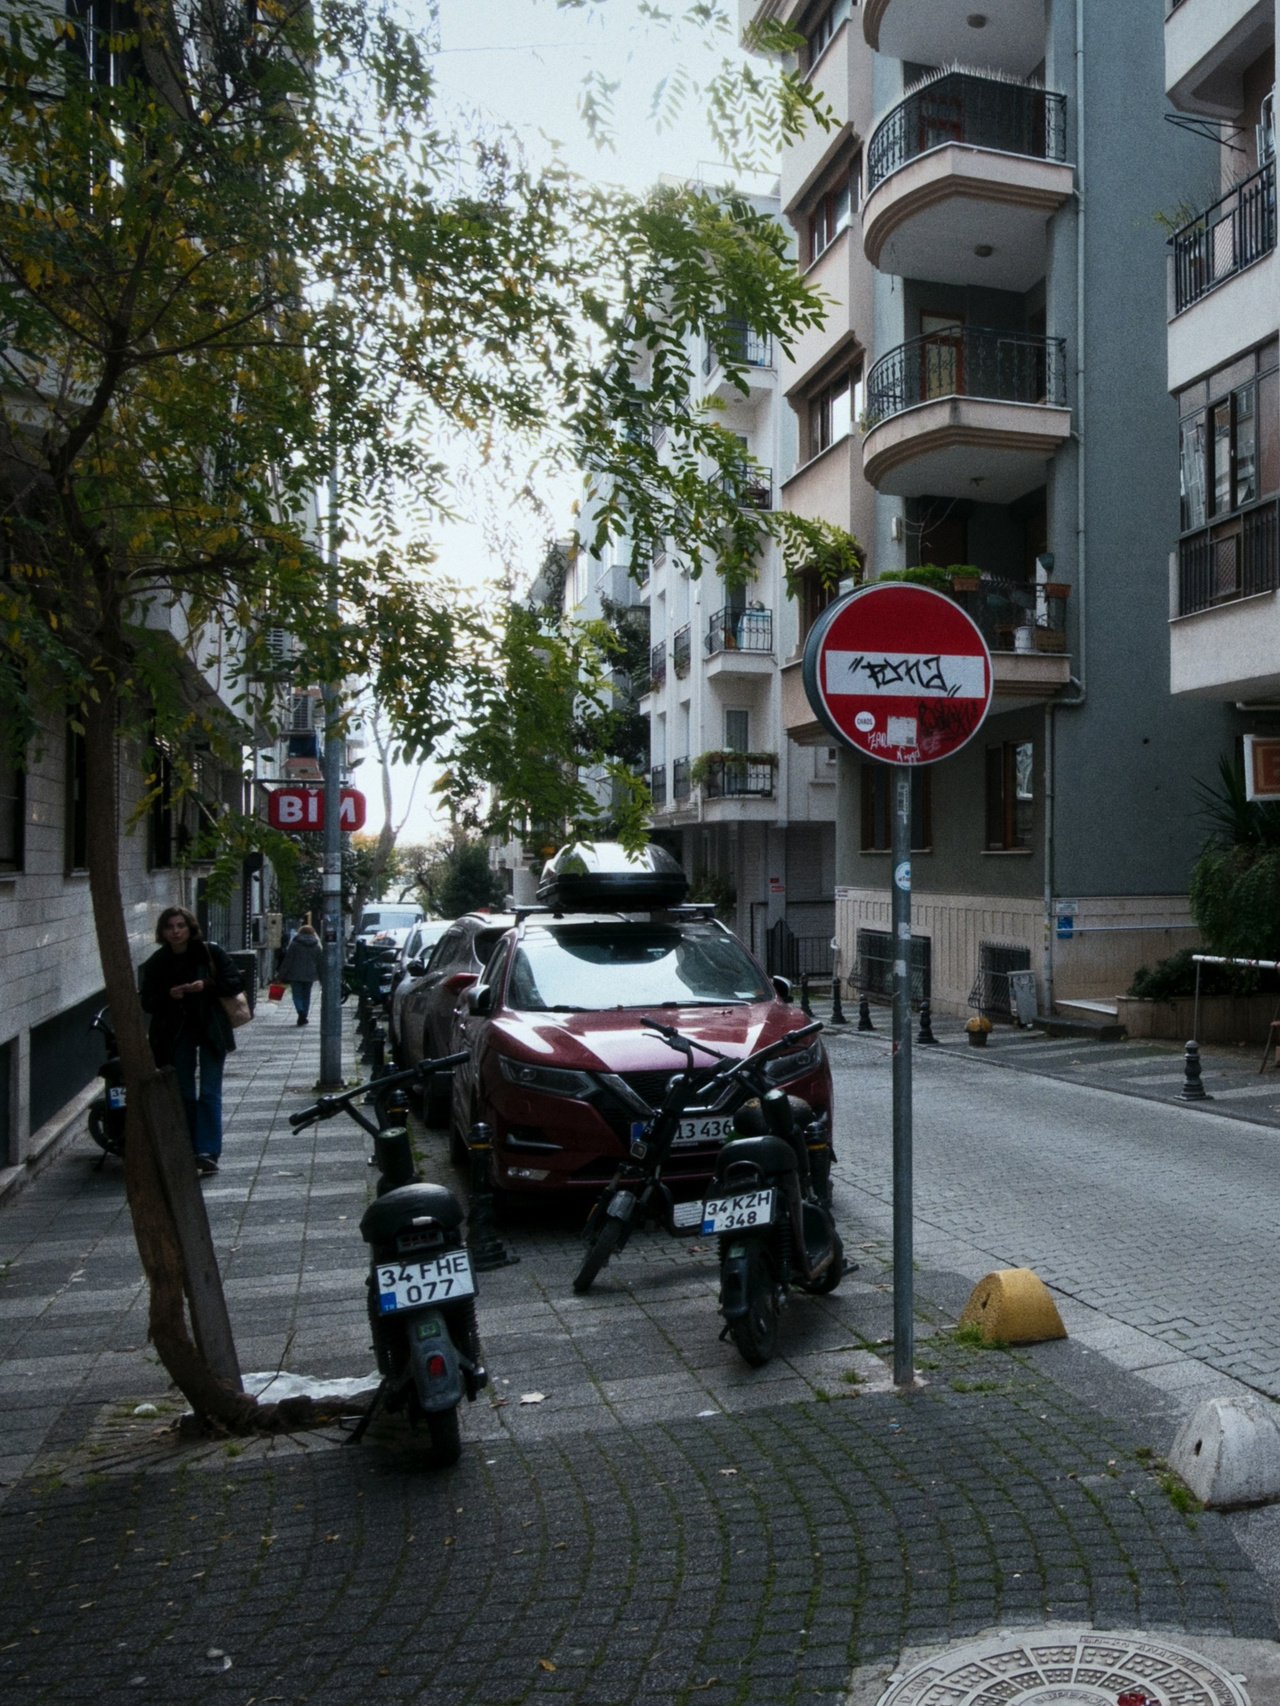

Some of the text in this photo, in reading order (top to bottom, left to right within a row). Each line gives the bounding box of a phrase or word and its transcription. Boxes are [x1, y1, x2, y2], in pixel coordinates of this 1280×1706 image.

[707, 1192, 770, 1216] 34 KZH
[724, 1211, 757, 1229] 348
[381, 1255, 468, 1287] 34 FHE
[406, 1278, 454, 1303] 077
[1032, 1691, 1108, 1706] SUPERO
